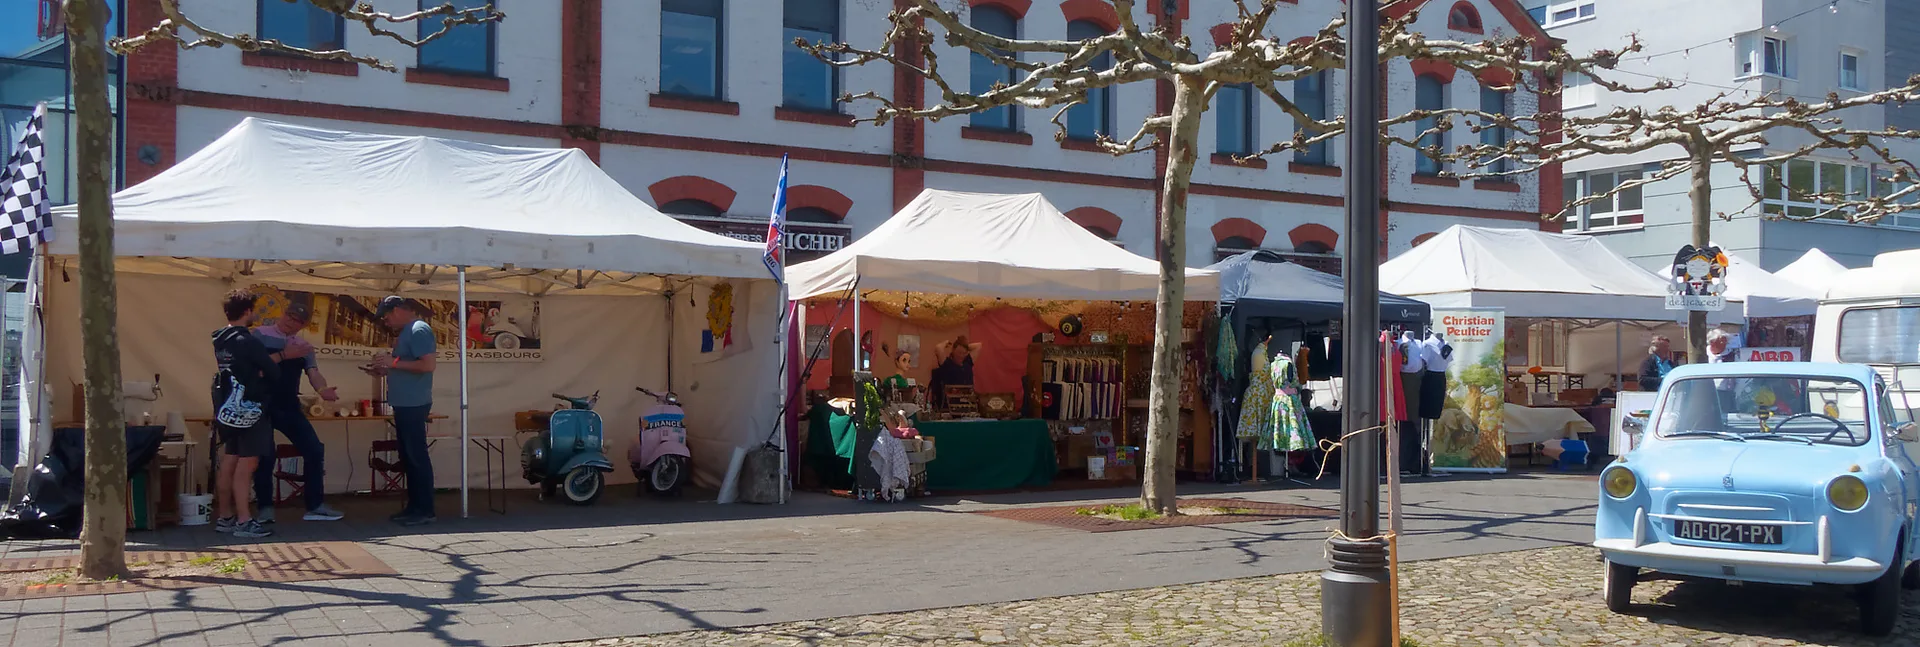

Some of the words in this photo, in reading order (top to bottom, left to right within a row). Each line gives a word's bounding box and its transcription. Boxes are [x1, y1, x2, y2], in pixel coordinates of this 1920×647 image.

[784, 231, 845, 252] ICHEL
[1442, 315, 1495, 326] Christian
[1446, 326, 1492, 337] Peultier
[312, 346, 373, 357] COOTER
[444, 350, 541, 360] STRASBOURG
[649, 420, 682, 429] FRANCE
[1679, 520, 1775, 544] AD-021-PX
